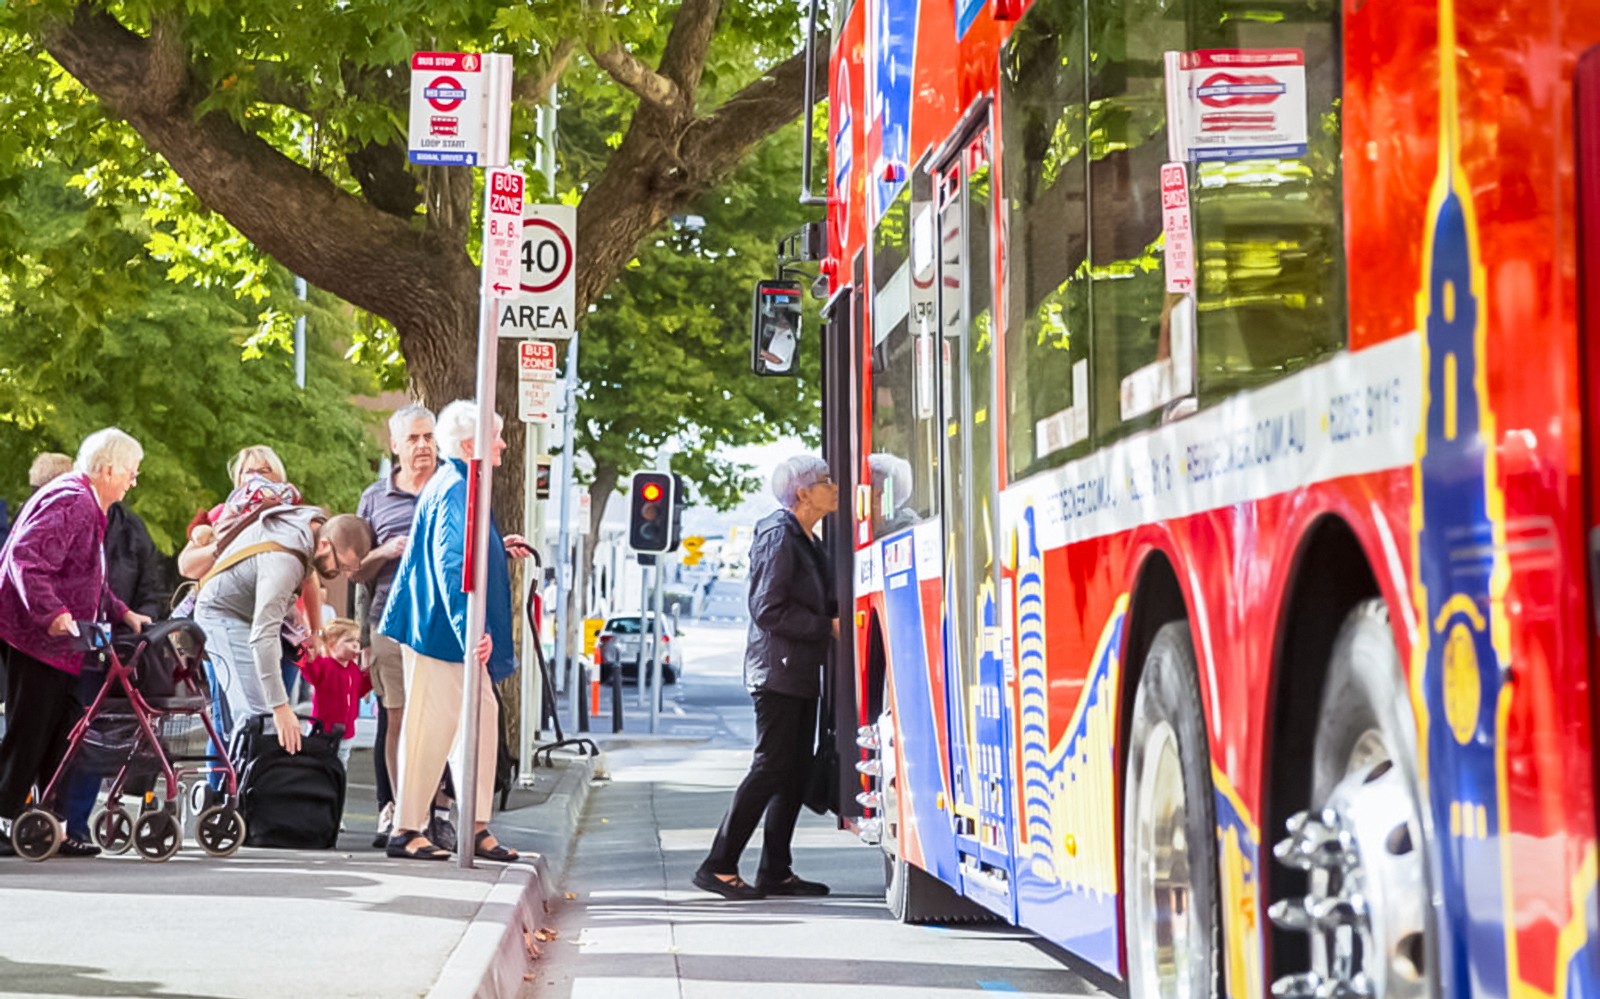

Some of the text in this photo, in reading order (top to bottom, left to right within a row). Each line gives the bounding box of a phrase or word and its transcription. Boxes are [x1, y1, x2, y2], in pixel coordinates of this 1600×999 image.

[417, 56, 476, 70] BUS STOP A
[421, 139, 465, 148] LOOP START
[495, 174, 519, 193] BUS
[491, 194, 522, 214] ZONE
[520, 239, 559, 273] 40
[500, 305, 568, 330] AREA
[525, 344, 550, 357] BUS
[522, 356, 553, 369] ZONE
